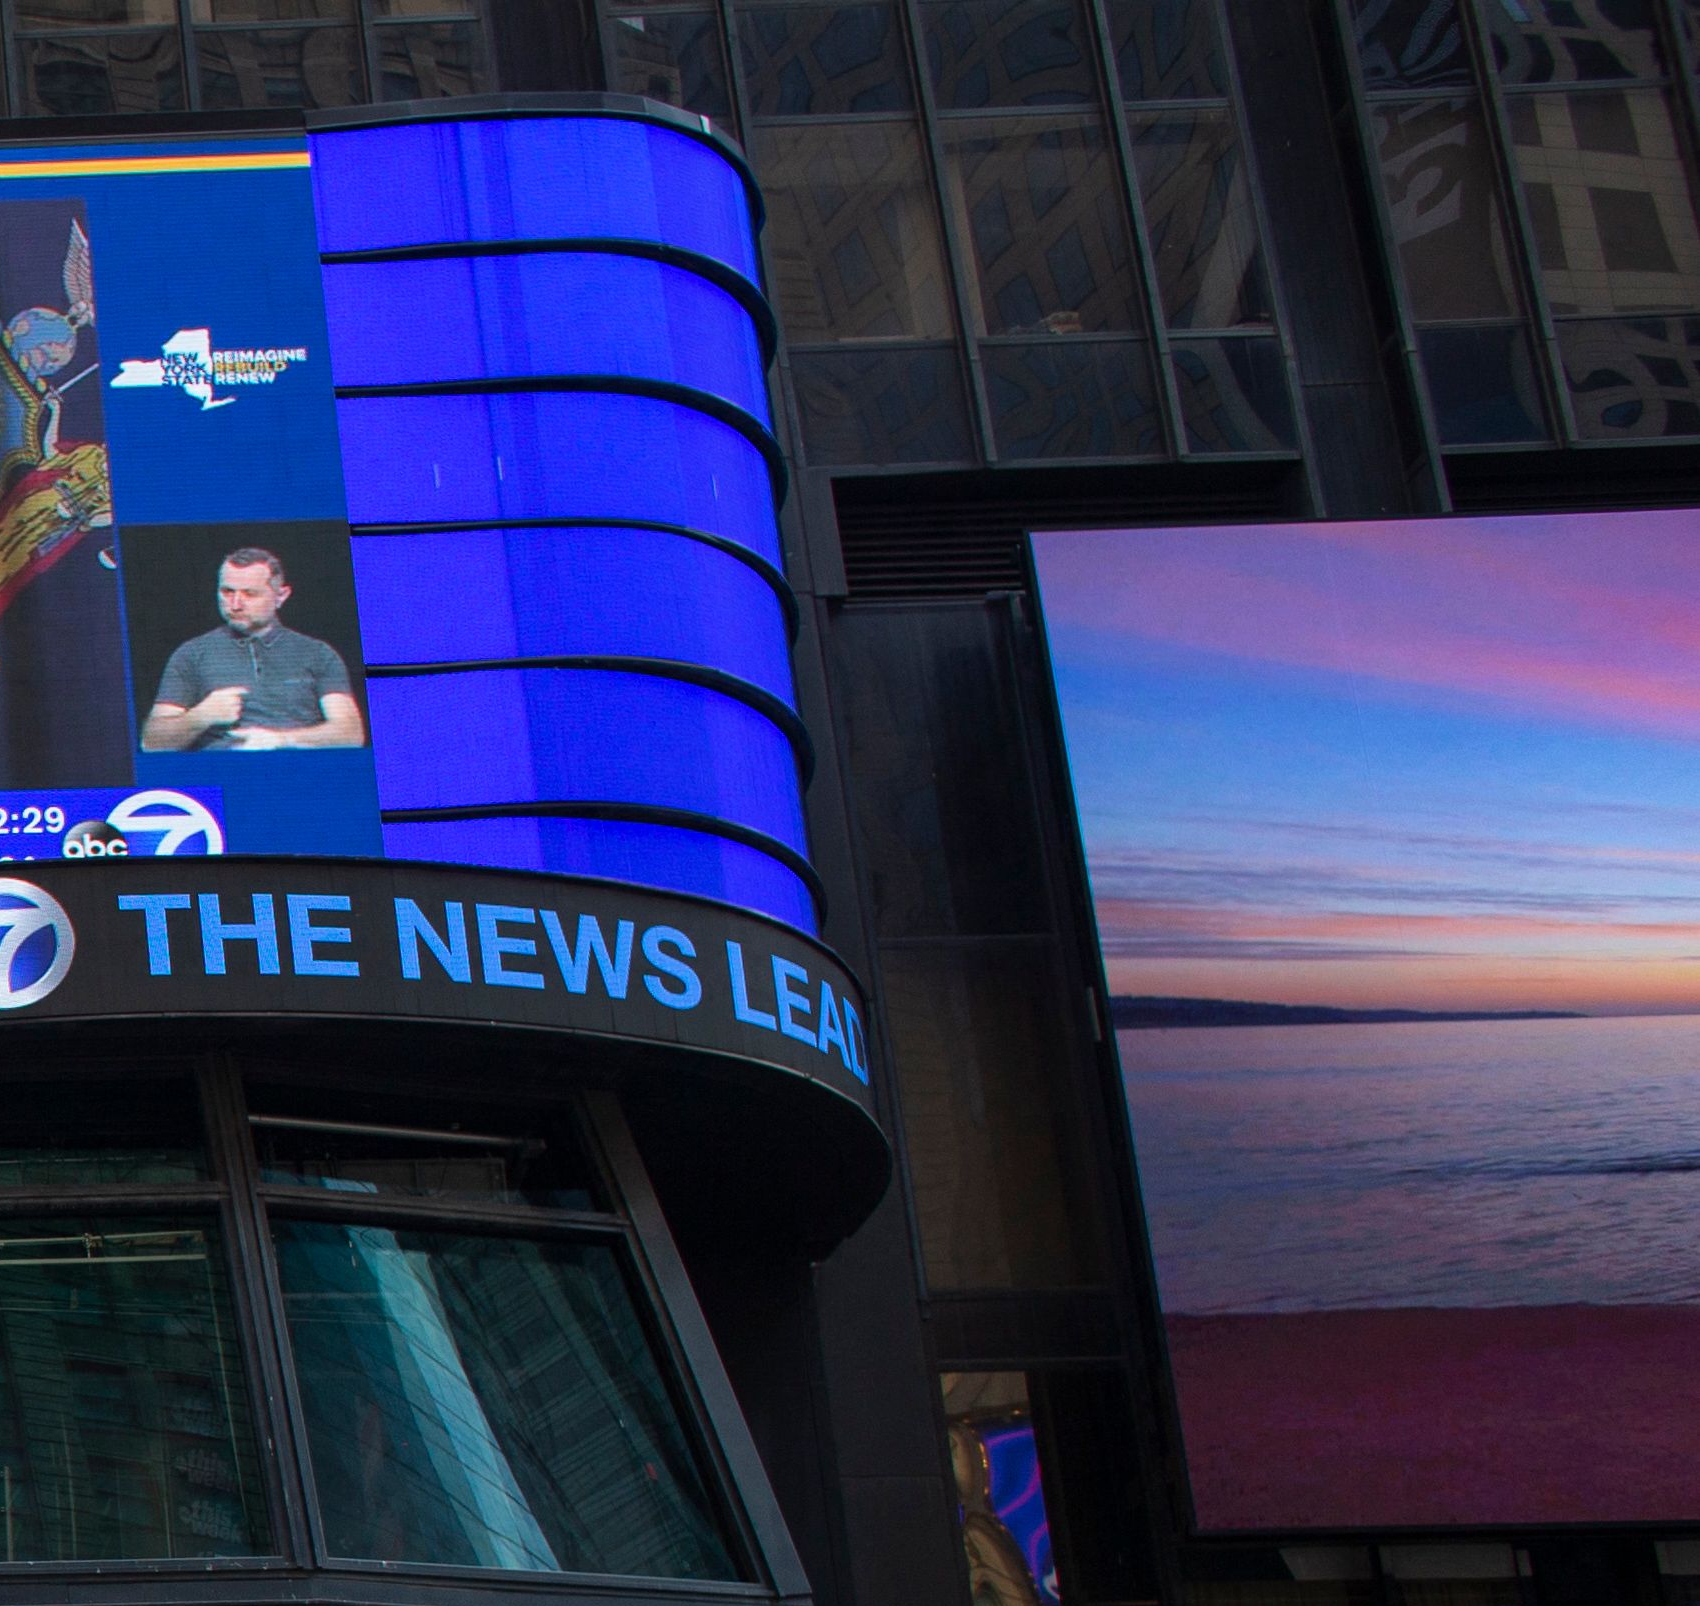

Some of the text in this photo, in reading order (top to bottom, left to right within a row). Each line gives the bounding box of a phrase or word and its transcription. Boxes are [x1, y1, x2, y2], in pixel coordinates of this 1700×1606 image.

[213, 349, 307, 362] REIMAGINE
[213, 361, 287, 373] REBUILD
[214, 372, 276, 384] RENEW
[118, 893, 361, 978] THE
[394, 897, 703, 1011] NEWS
